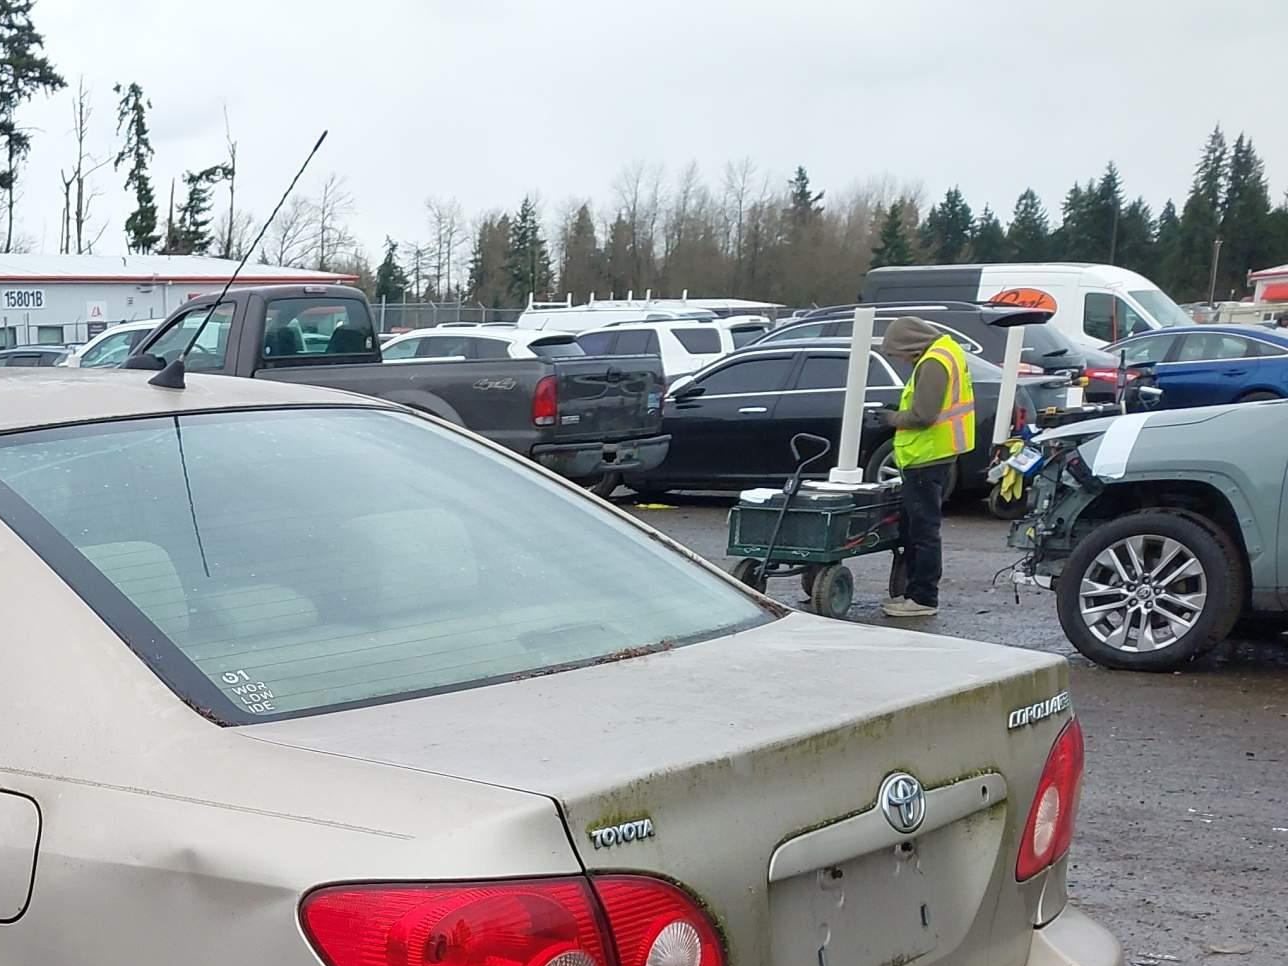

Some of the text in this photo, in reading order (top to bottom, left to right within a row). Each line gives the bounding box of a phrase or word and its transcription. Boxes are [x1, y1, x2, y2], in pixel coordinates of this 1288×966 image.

[4, 291, 43, 308] 15801B
[248, 700, 276, 713] IDE
[591, 818, 654, 848] TOYOTA
